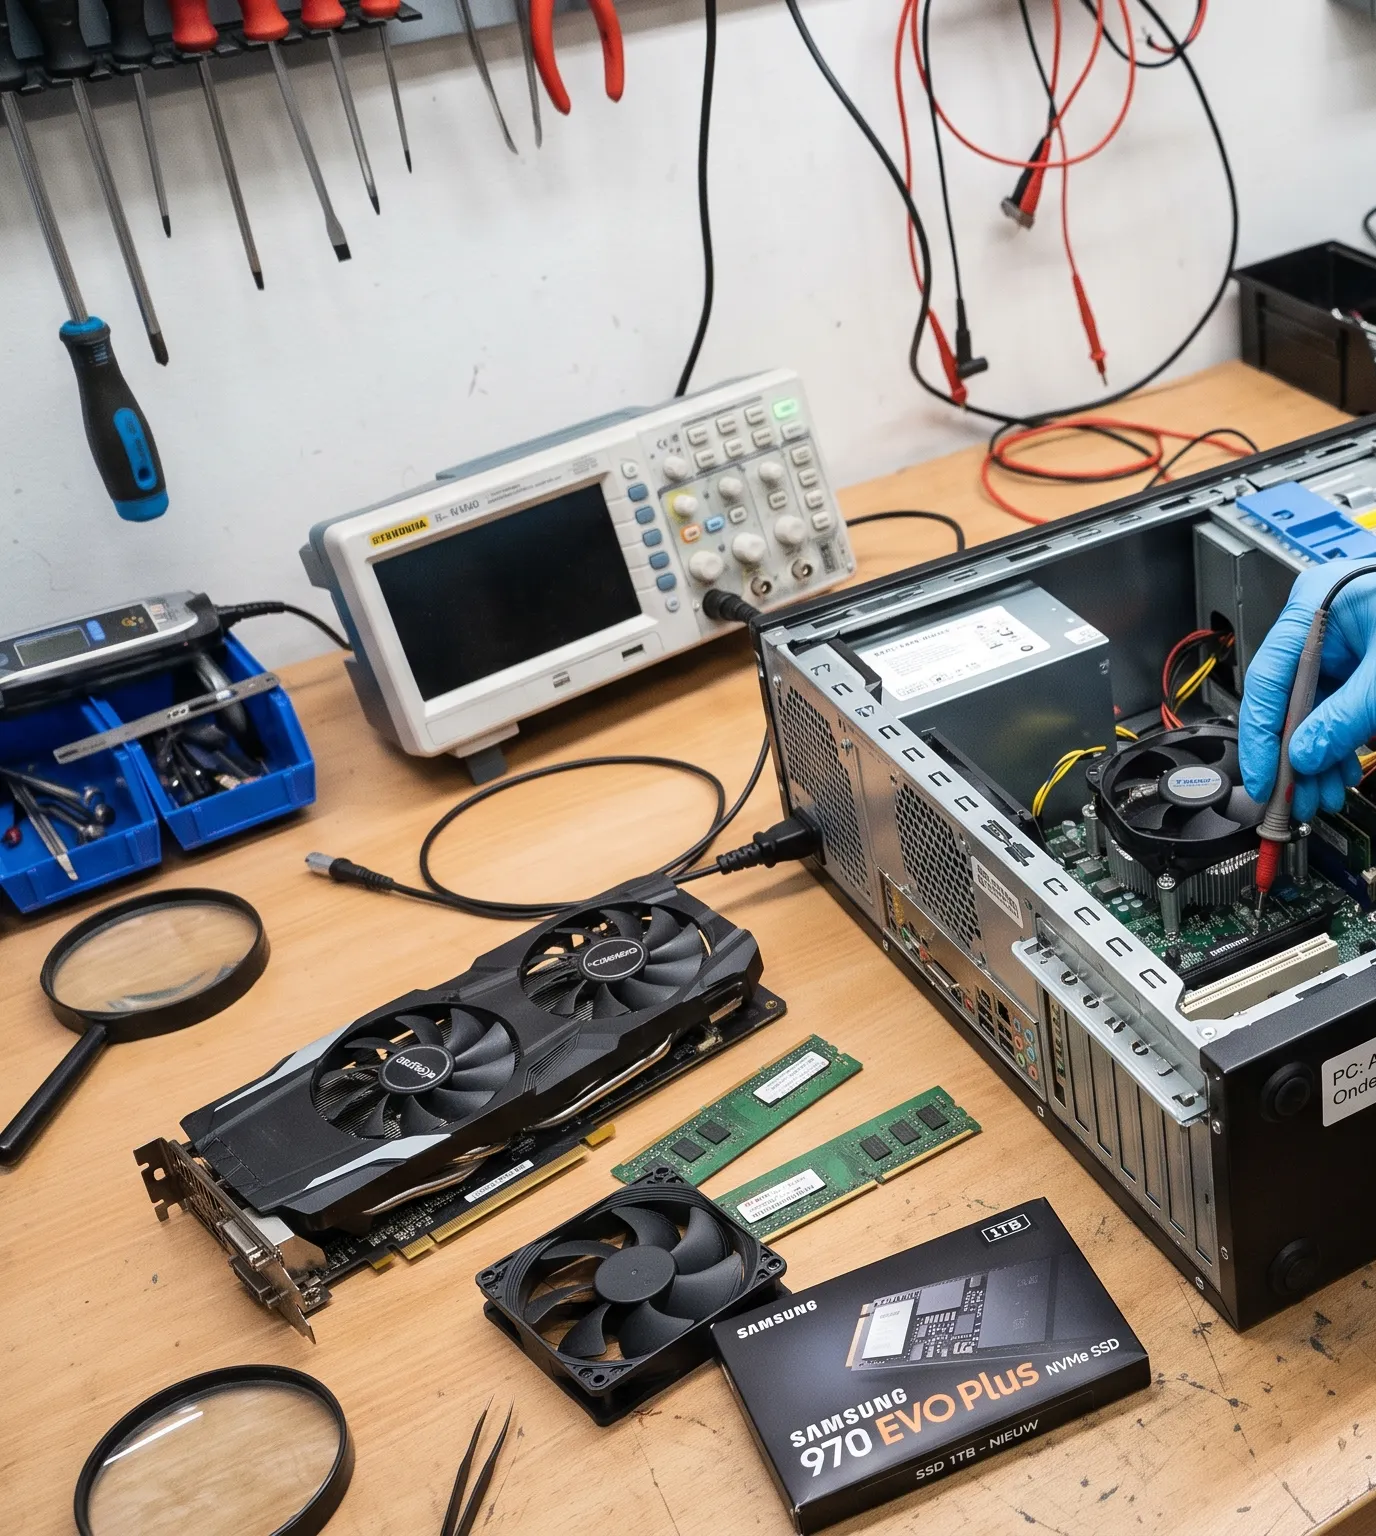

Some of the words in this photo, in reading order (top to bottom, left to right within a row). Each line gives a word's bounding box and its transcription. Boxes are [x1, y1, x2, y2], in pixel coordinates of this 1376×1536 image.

[1333, 1062, 1363, 1086] PC:
[989, 1219, 1022, 1238] 1TB
[736, 1299, 818, 1339] SAMSUNG
[789, 1388, 907, 1448] SAMSUNG
[800, 1427, 873, 1478] 970
[875, 1393, 956, 1446] EVO
[956, 1361, 1040, 1412] Plus
[1045, 1351, 1089, 1376] NVMe
[1090, 1337, 1120, 1358] SSD
[916, 1460, 945, 1481] SSD
[950, 1447, 976, 1465] 1TB
[989, 1419, 1039, 1449] NIEUW
